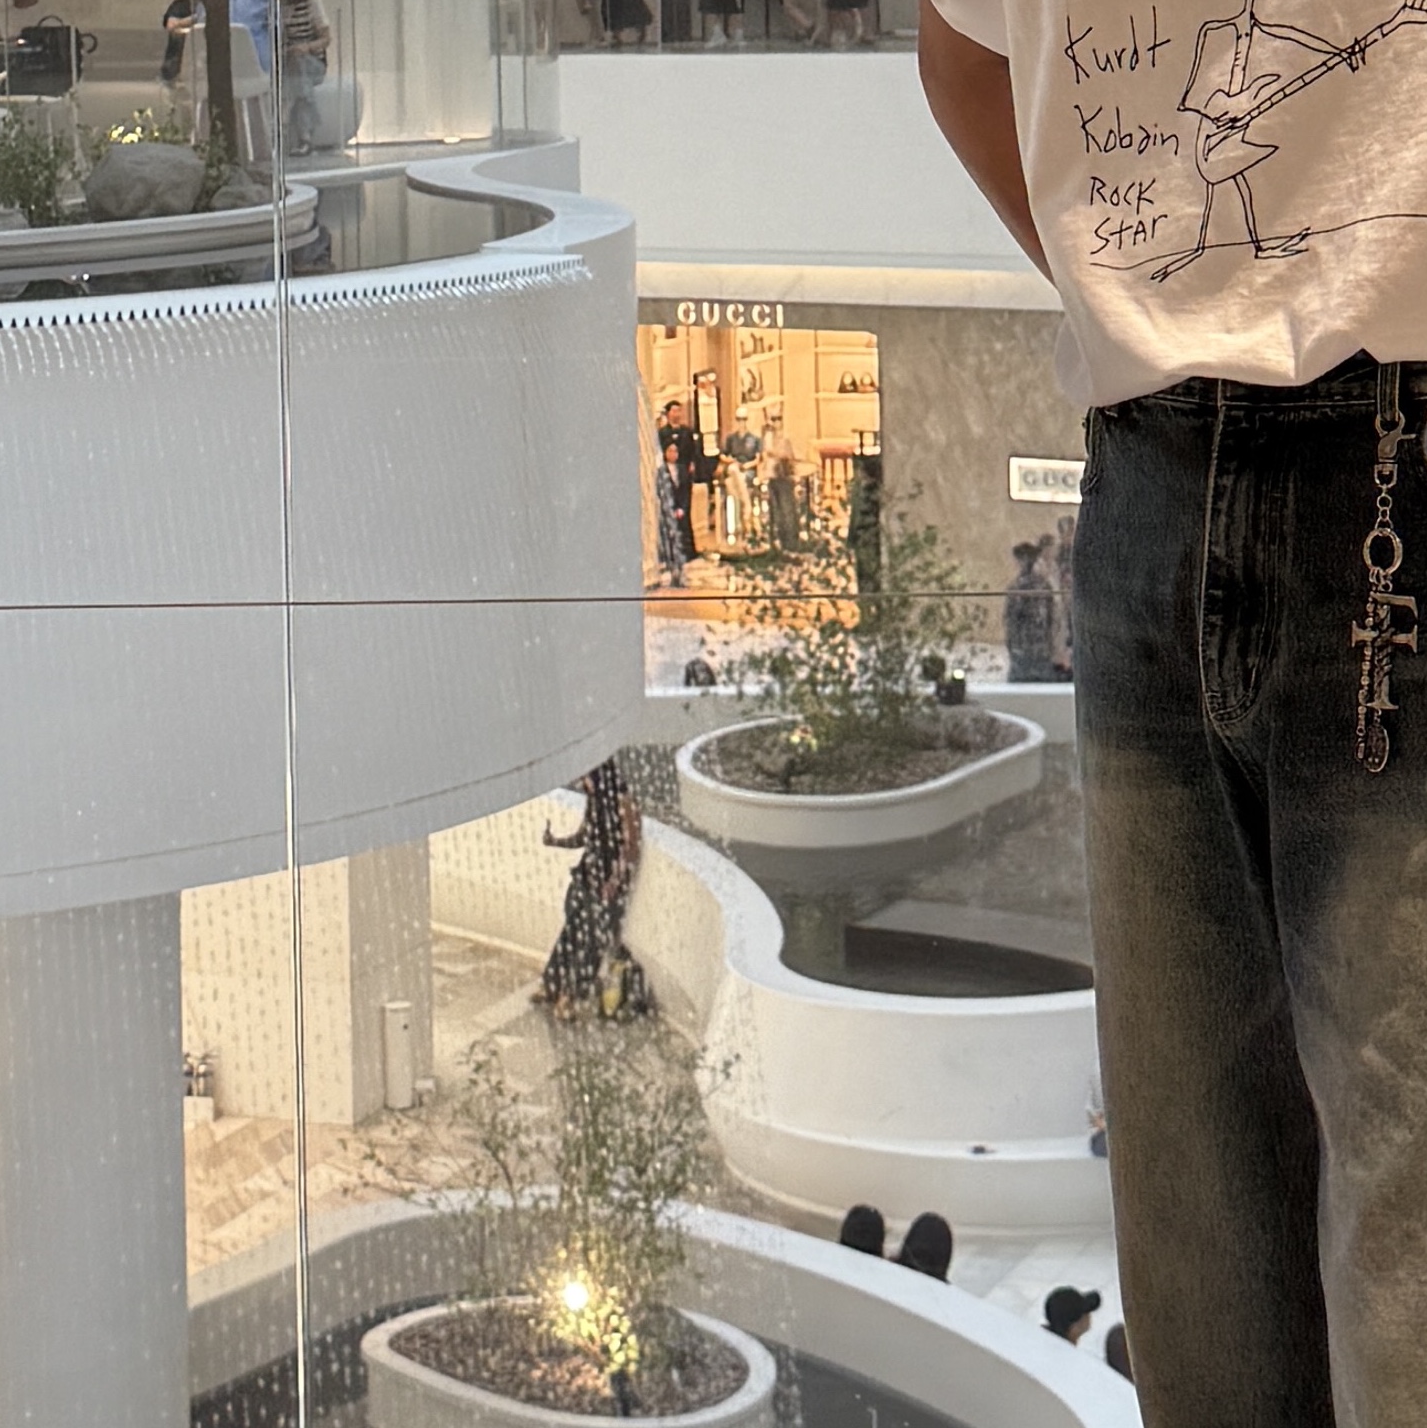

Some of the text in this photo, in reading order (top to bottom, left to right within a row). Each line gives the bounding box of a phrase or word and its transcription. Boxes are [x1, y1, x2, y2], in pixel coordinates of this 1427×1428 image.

[1065, 5, 1172, 85] Kurdt
[1073, 103, 1180, 156] Kobain
[677, 301, 785, 328] GUCCI
